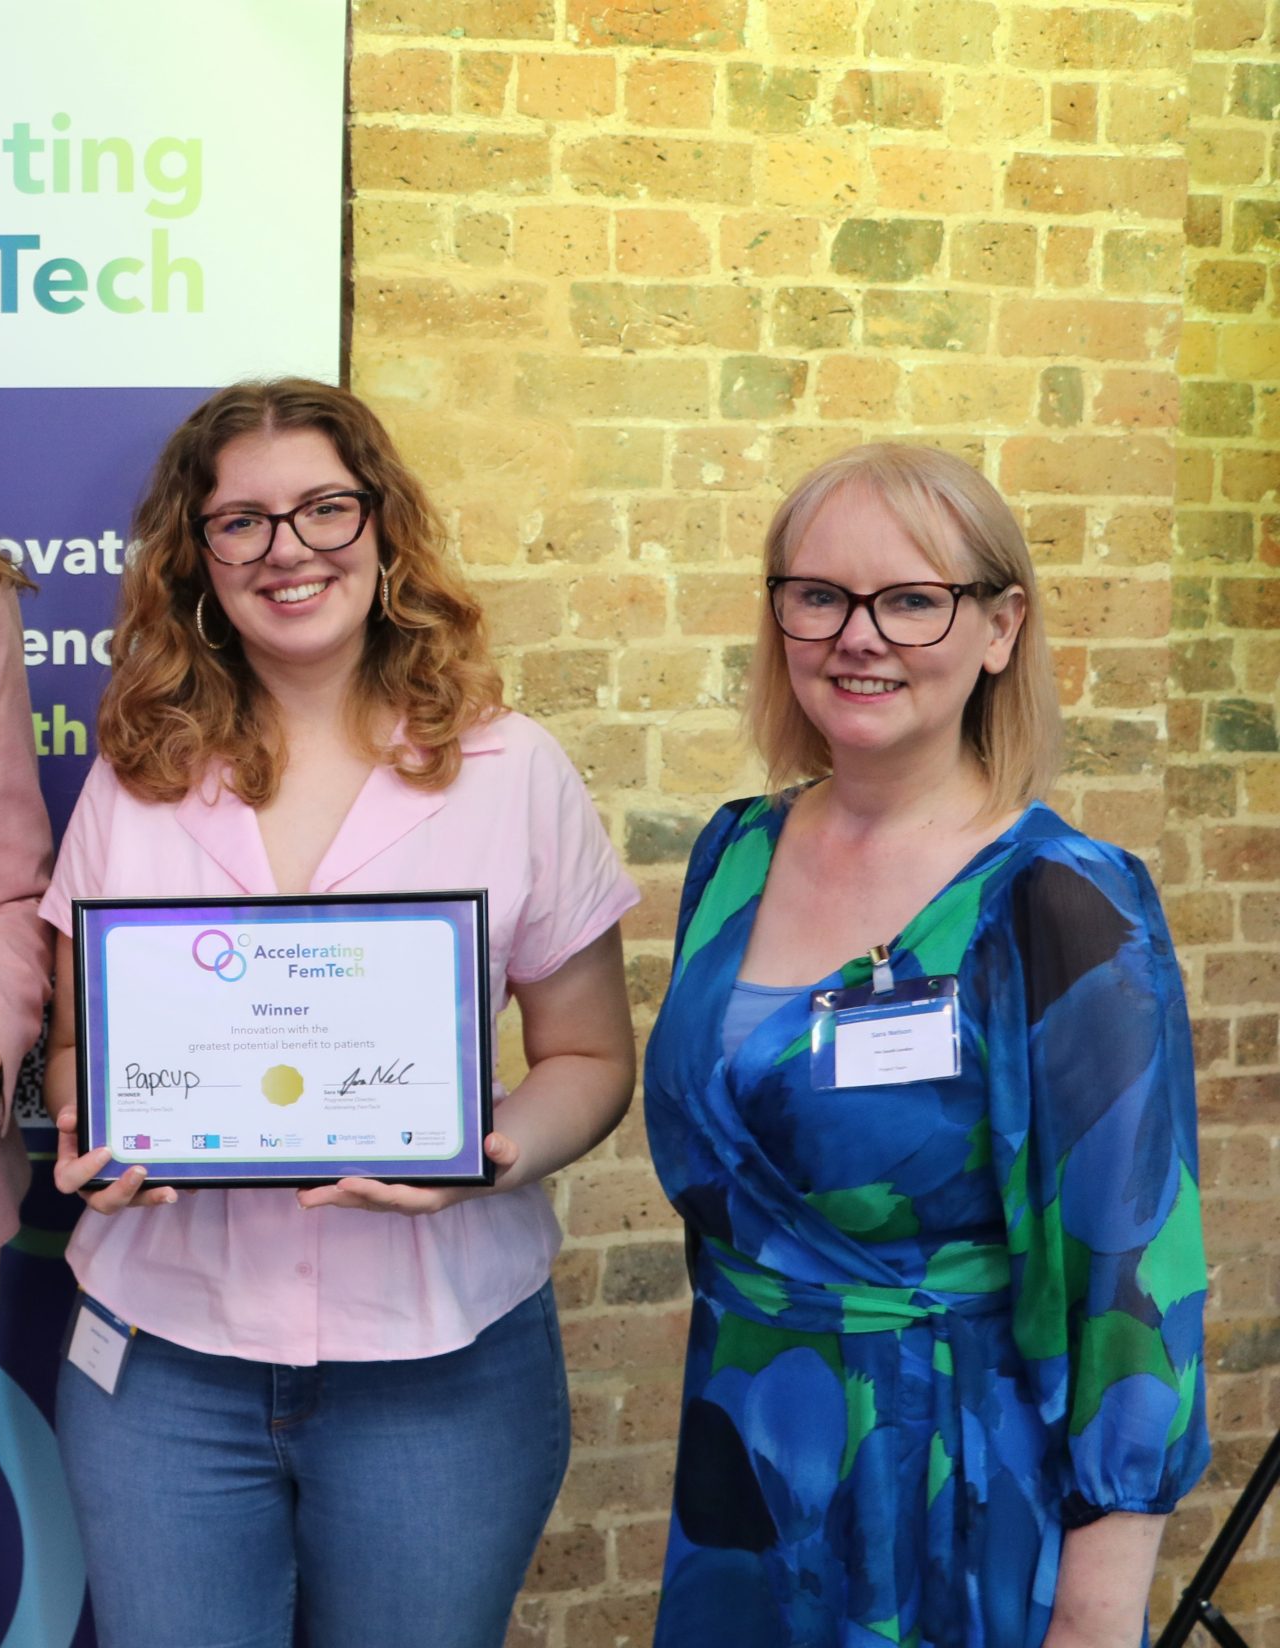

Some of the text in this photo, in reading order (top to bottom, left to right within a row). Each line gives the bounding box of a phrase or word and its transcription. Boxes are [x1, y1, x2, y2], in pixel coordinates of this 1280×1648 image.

[254, 943, 364, 961] Accelerating
[288, 961, 365, 978] FemTech
[251, 1003, 310, 1017] Winner
[231, 1024, 329, 1036] Innovation with the
[188, 1039, 375, 1054] greatest potential benefit to patients
[125, 1062, 201, 1100] Papcup
